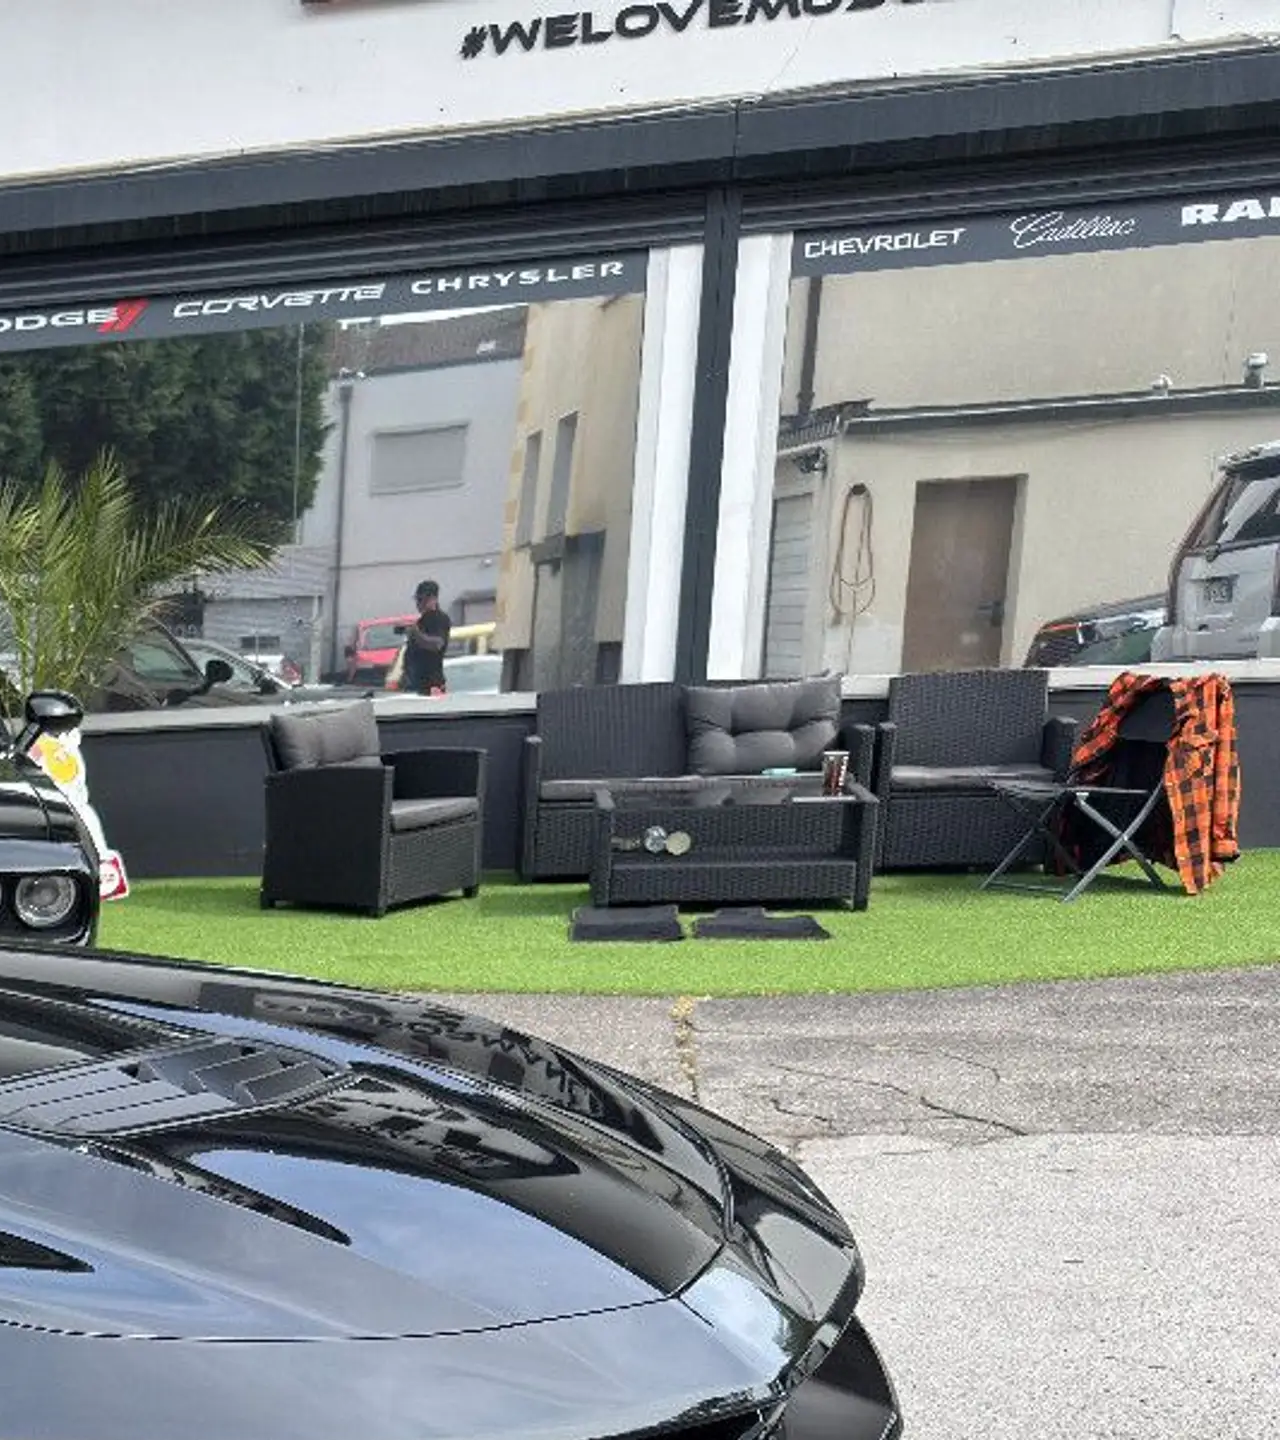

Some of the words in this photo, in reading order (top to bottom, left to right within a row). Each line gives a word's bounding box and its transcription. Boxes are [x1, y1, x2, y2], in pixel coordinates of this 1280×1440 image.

[803, 227, 966, 260] CHEVROLET
[1008, 211, 1139, 250] Cadillac
[1180, 195, 1280, 226] RA
[173, 282, 387, 318] CORVETTE
[411, 260, 624, 296] CHRYSLER
